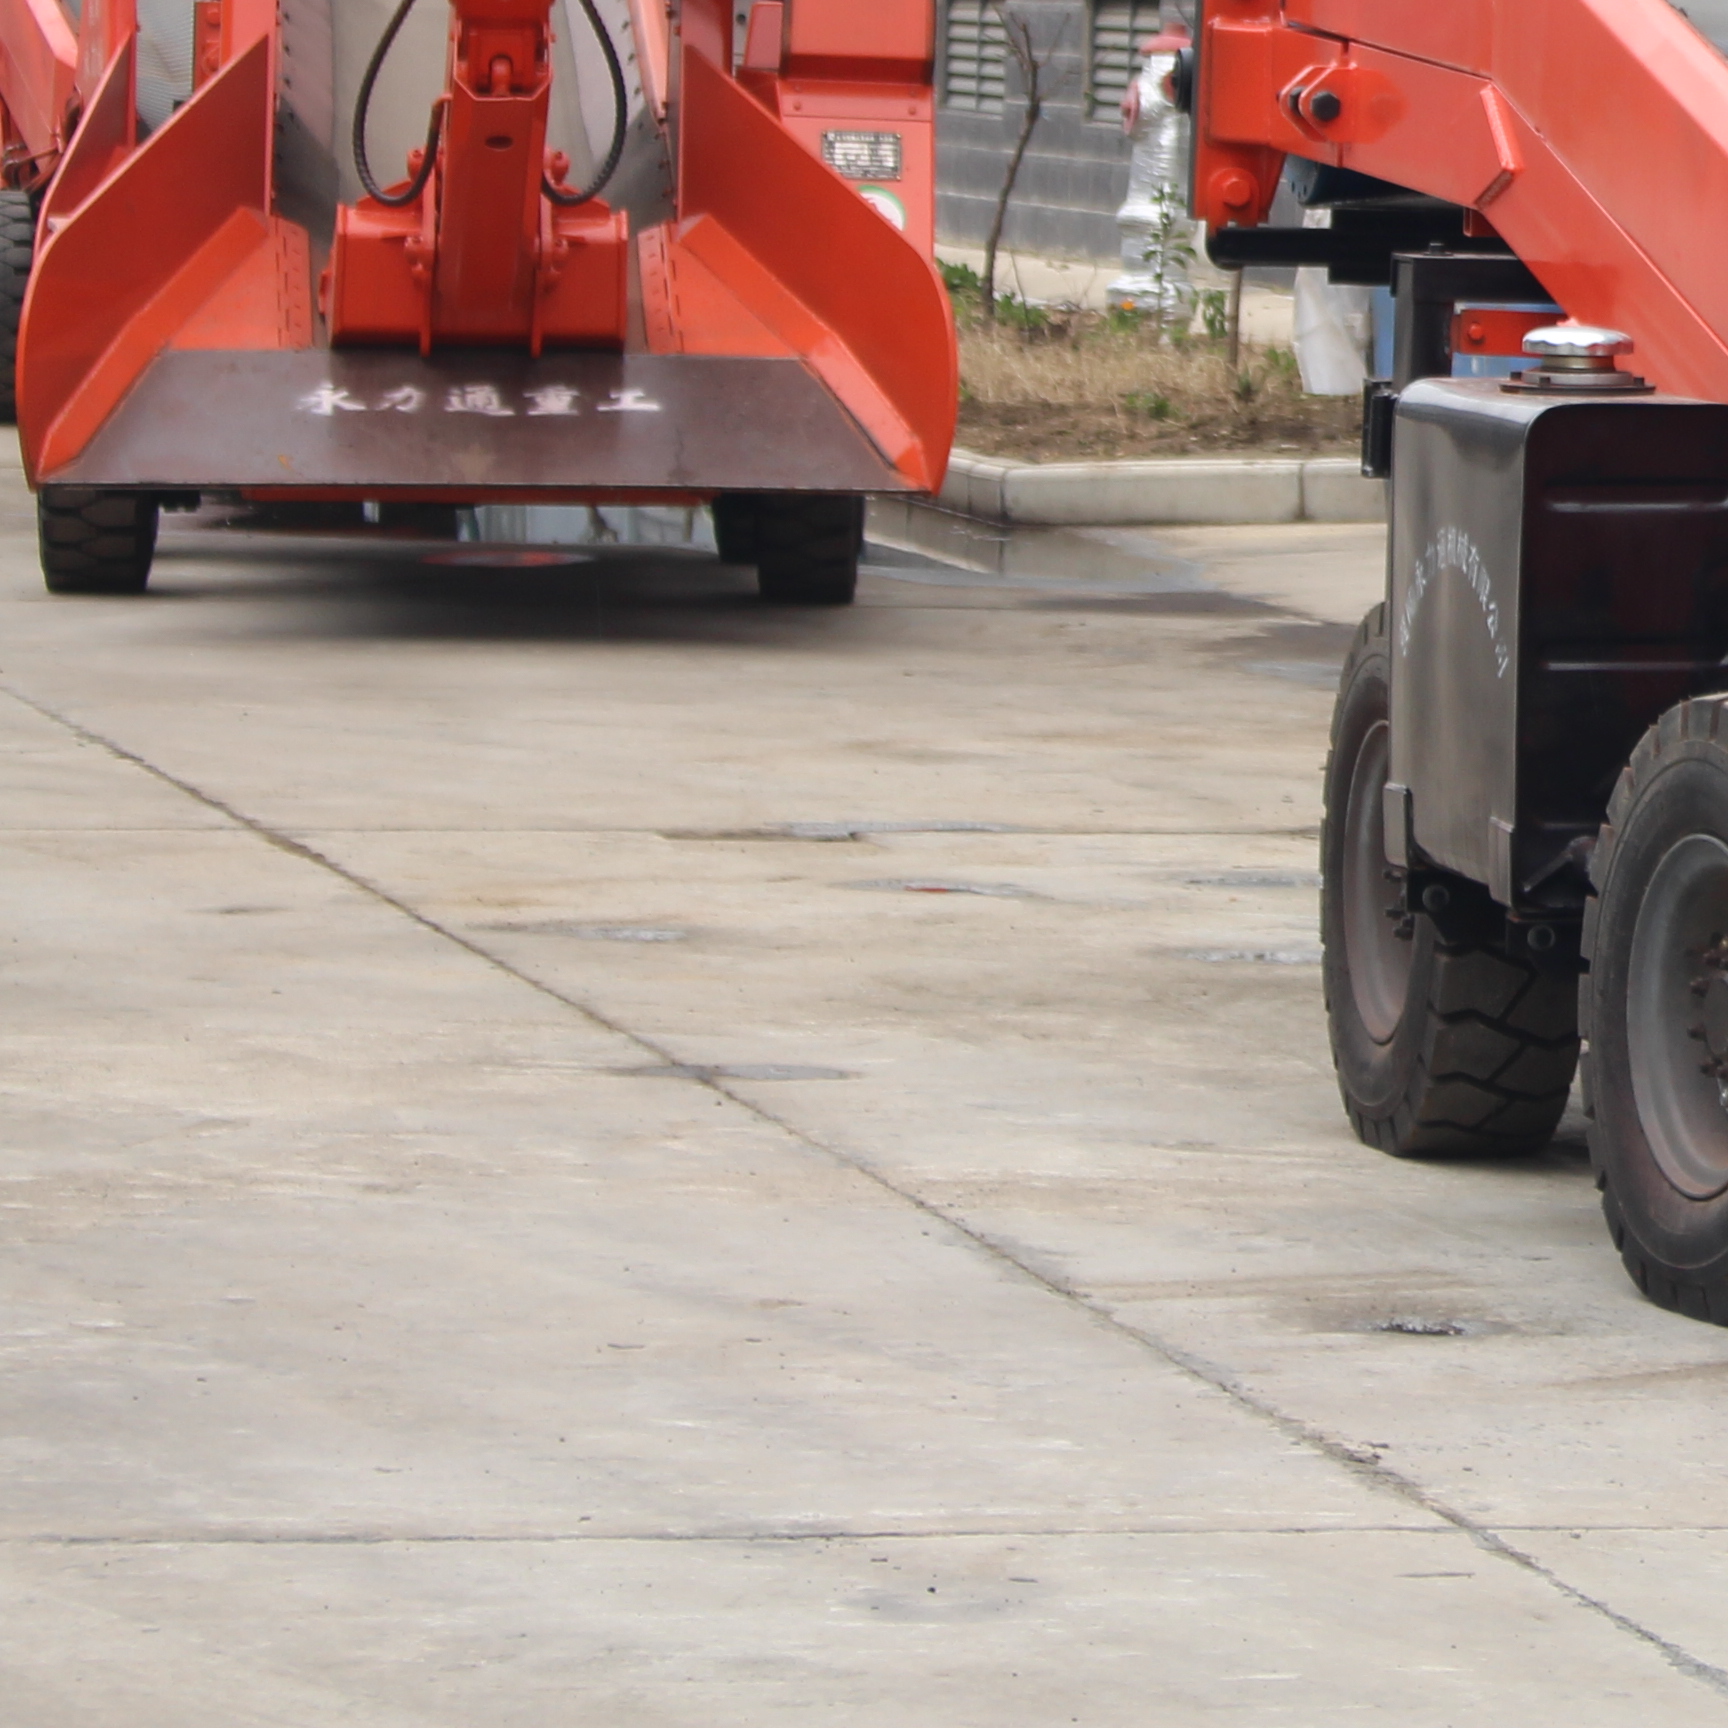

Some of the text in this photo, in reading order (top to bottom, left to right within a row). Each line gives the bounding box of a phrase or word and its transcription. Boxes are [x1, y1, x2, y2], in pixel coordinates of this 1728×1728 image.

[298, 382, 661, 417] 永力通重工
